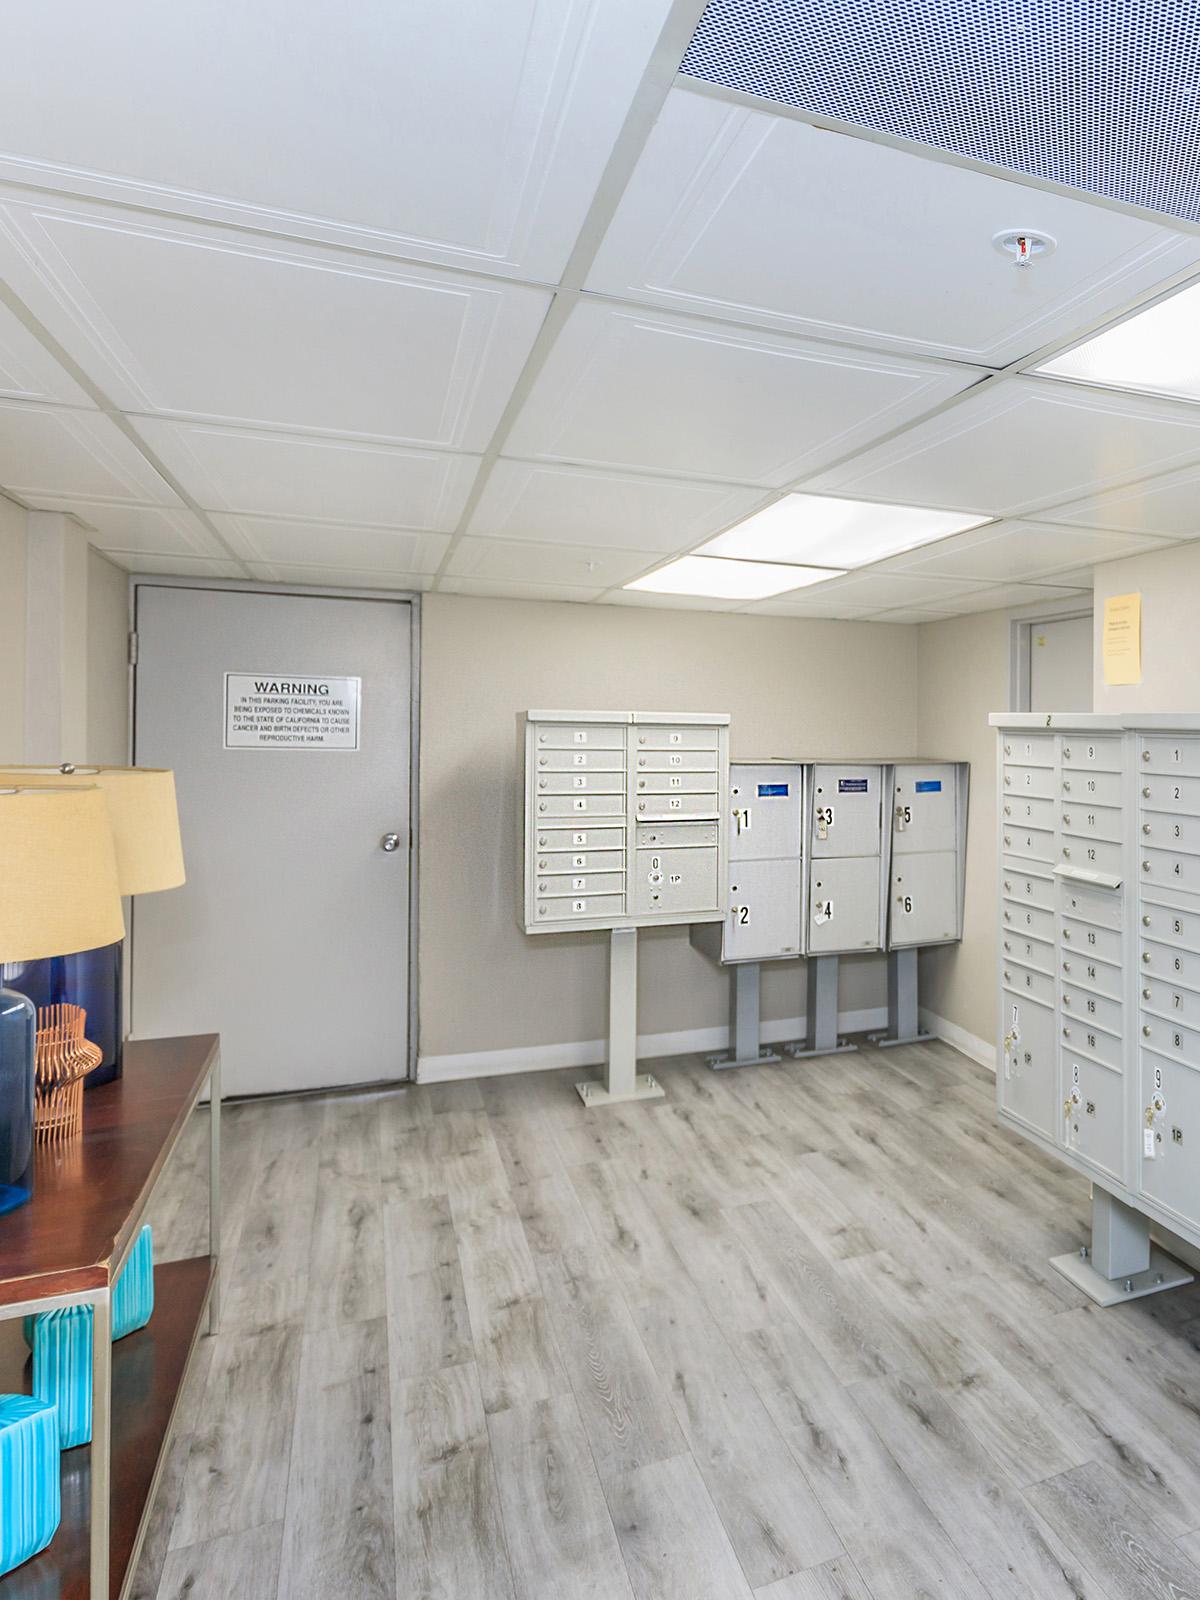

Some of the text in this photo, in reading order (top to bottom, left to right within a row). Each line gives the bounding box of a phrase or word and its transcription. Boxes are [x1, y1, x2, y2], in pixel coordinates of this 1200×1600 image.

[255, 682, 329, 695] WARNING
[1046, 715, 1051, 726] 2
[1088, 781, 1095, 791] 10
[1175, 788, 1179, 799] 2
[825, 808, 832, 825] 3
[904, 807, 911, 822] 5
[1088, 815, 1095, 825] 11
[1175, 826, 1180, 837] 3
[1088, 850, 1095, 860] 12
[1175, 864, 1180, 874] 4
[905, 897, 912, 912] 6
[740, 907, 748, 924] 2
[824, 902, 831, 919] 4
[1175, 921, 1180, 932] 5
[1088, 933, 1095, 944] 13
[1175, 958, 1180, 970] 6
[1088, 967, 1095, 978] 14
[1088, 1001, 1095, 1012] 15
[1175, 997, 1180, 1008] 7
[1088, 1036, 1095, 1047] 16
[1175, 1035, 1180, 1046] 8
[1156, 1069, 1161, 1088] 9
[1087, 1103, 1095, 1113] 2P
[1172, 1129, 1182, 1142] 1P
